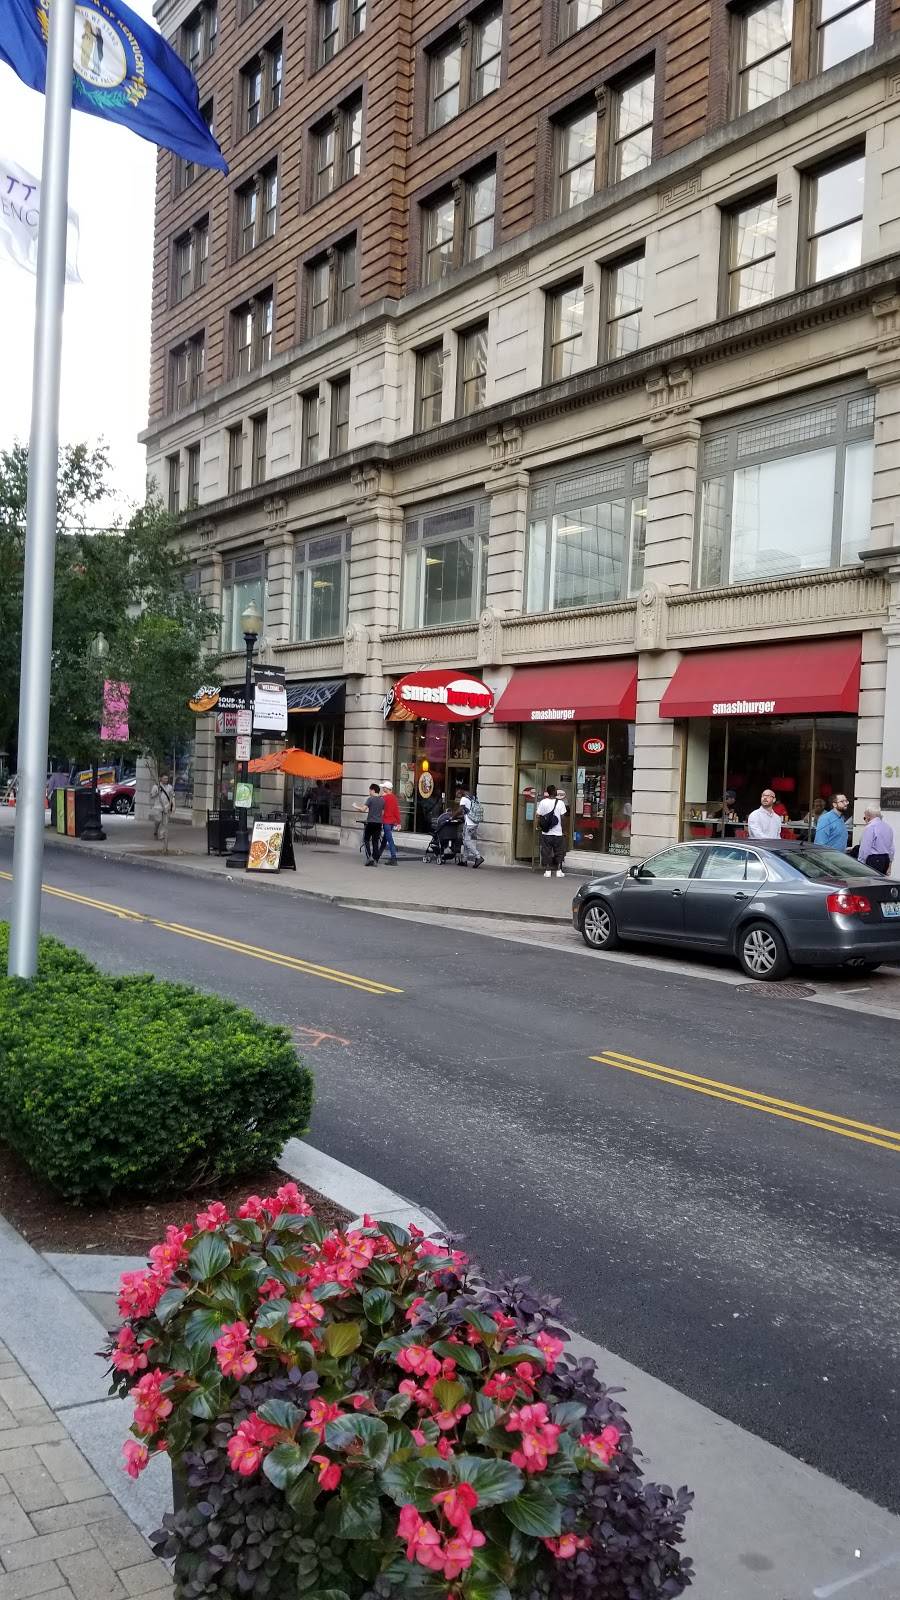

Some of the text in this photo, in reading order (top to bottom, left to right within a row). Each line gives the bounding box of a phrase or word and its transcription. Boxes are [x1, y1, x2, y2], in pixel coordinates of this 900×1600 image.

[117, 20, 145, 77] KENTUCKY
[401, 685, 494, 709] smashburger
[531, 708, 576, 721] smashburger
[712, 700, 776, 715] smashburger
